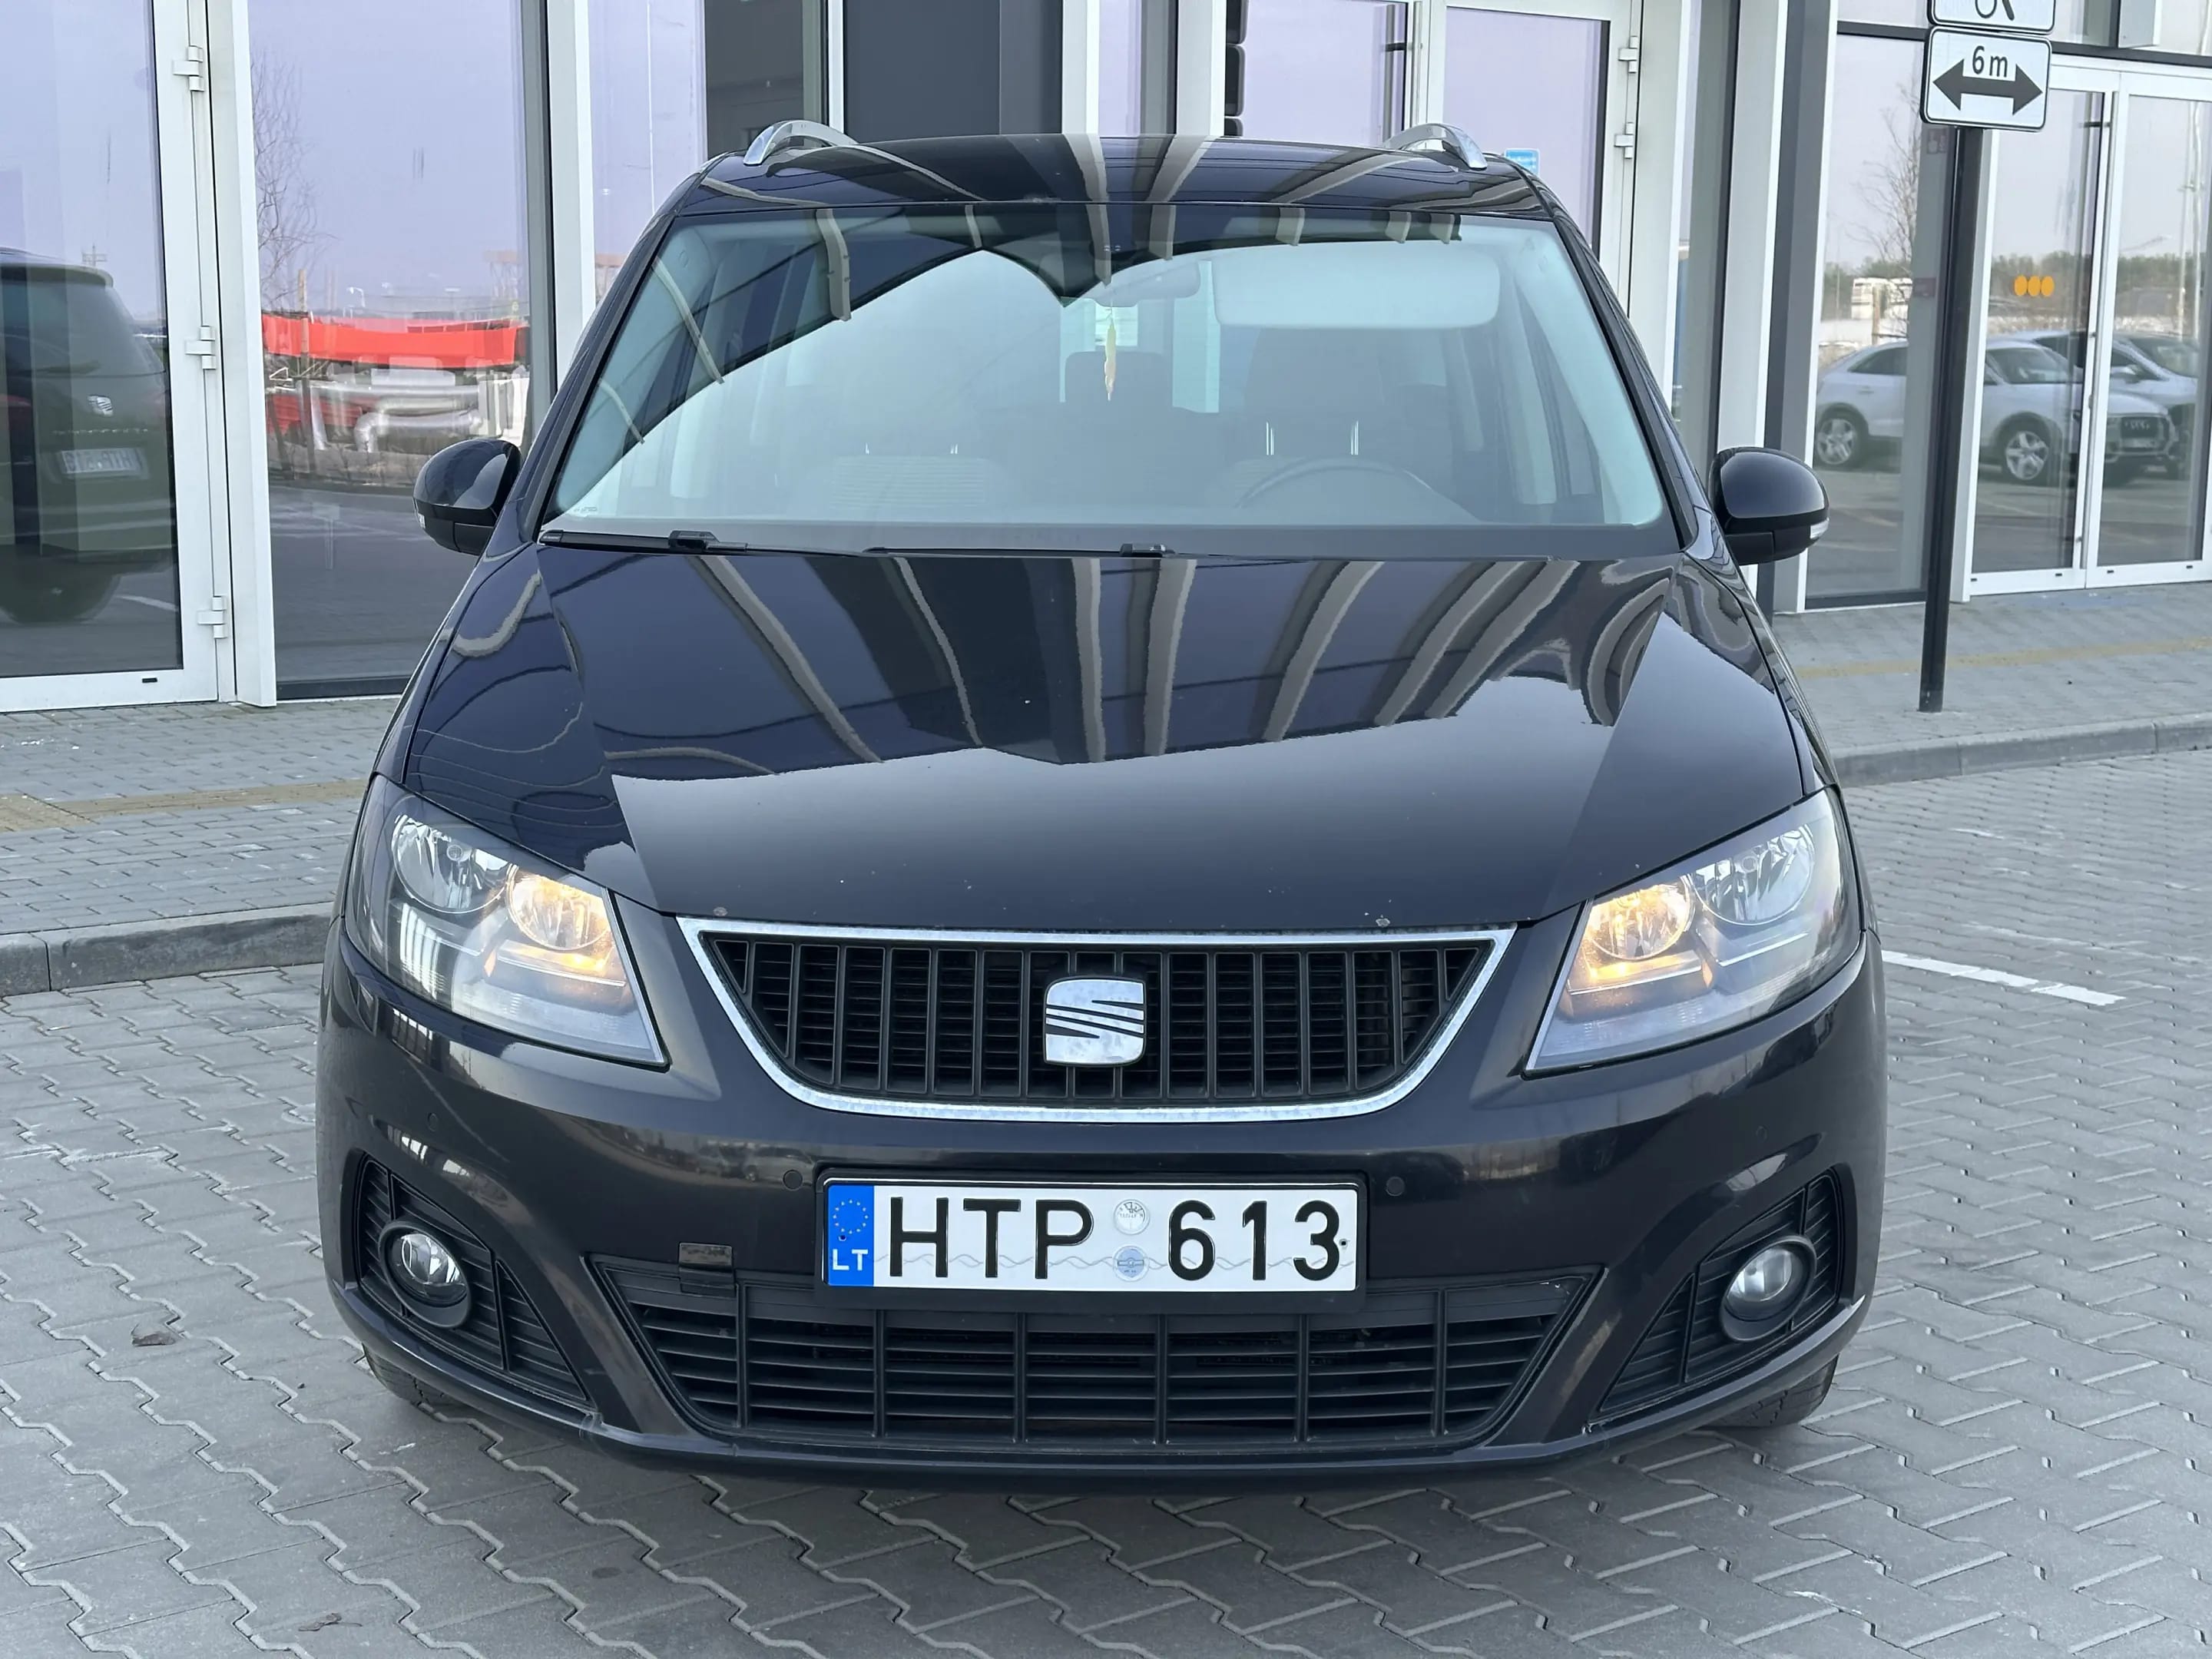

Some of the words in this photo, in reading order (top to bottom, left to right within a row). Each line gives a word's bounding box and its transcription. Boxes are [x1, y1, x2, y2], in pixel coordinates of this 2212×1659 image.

[832, 1248, 869, 1271] LT
[889, 1196, 1094, 1280] HTP
[1167, 1199, 1341, 1281] 613
